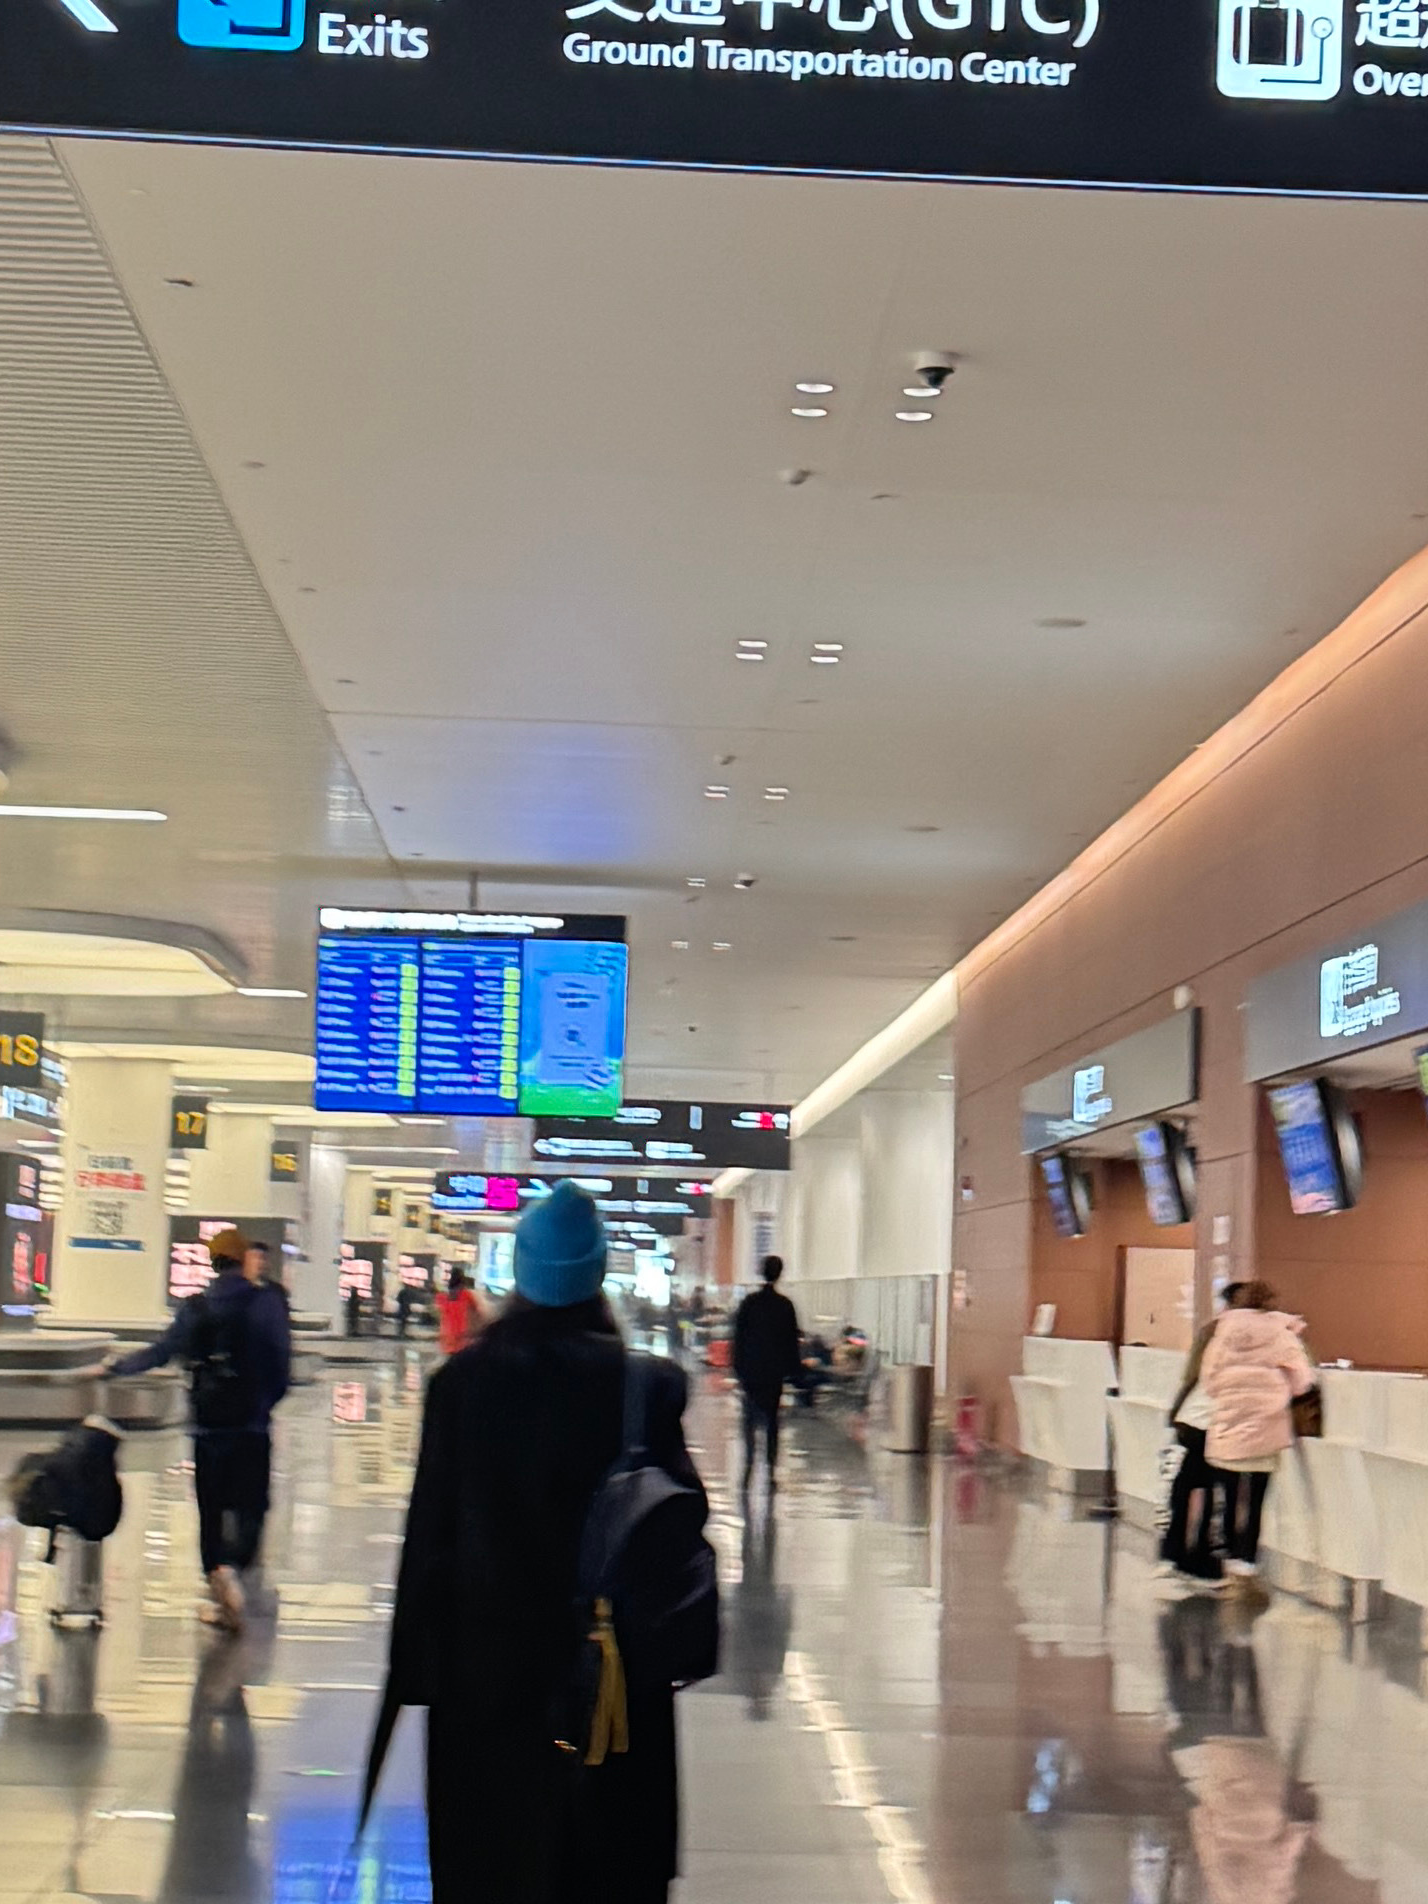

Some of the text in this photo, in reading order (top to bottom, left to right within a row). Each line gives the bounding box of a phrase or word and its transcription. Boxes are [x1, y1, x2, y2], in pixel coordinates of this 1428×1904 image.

[318, 12, 429, 59] Exits
[562, 32, 1077, 87] Ground Transportation Center
